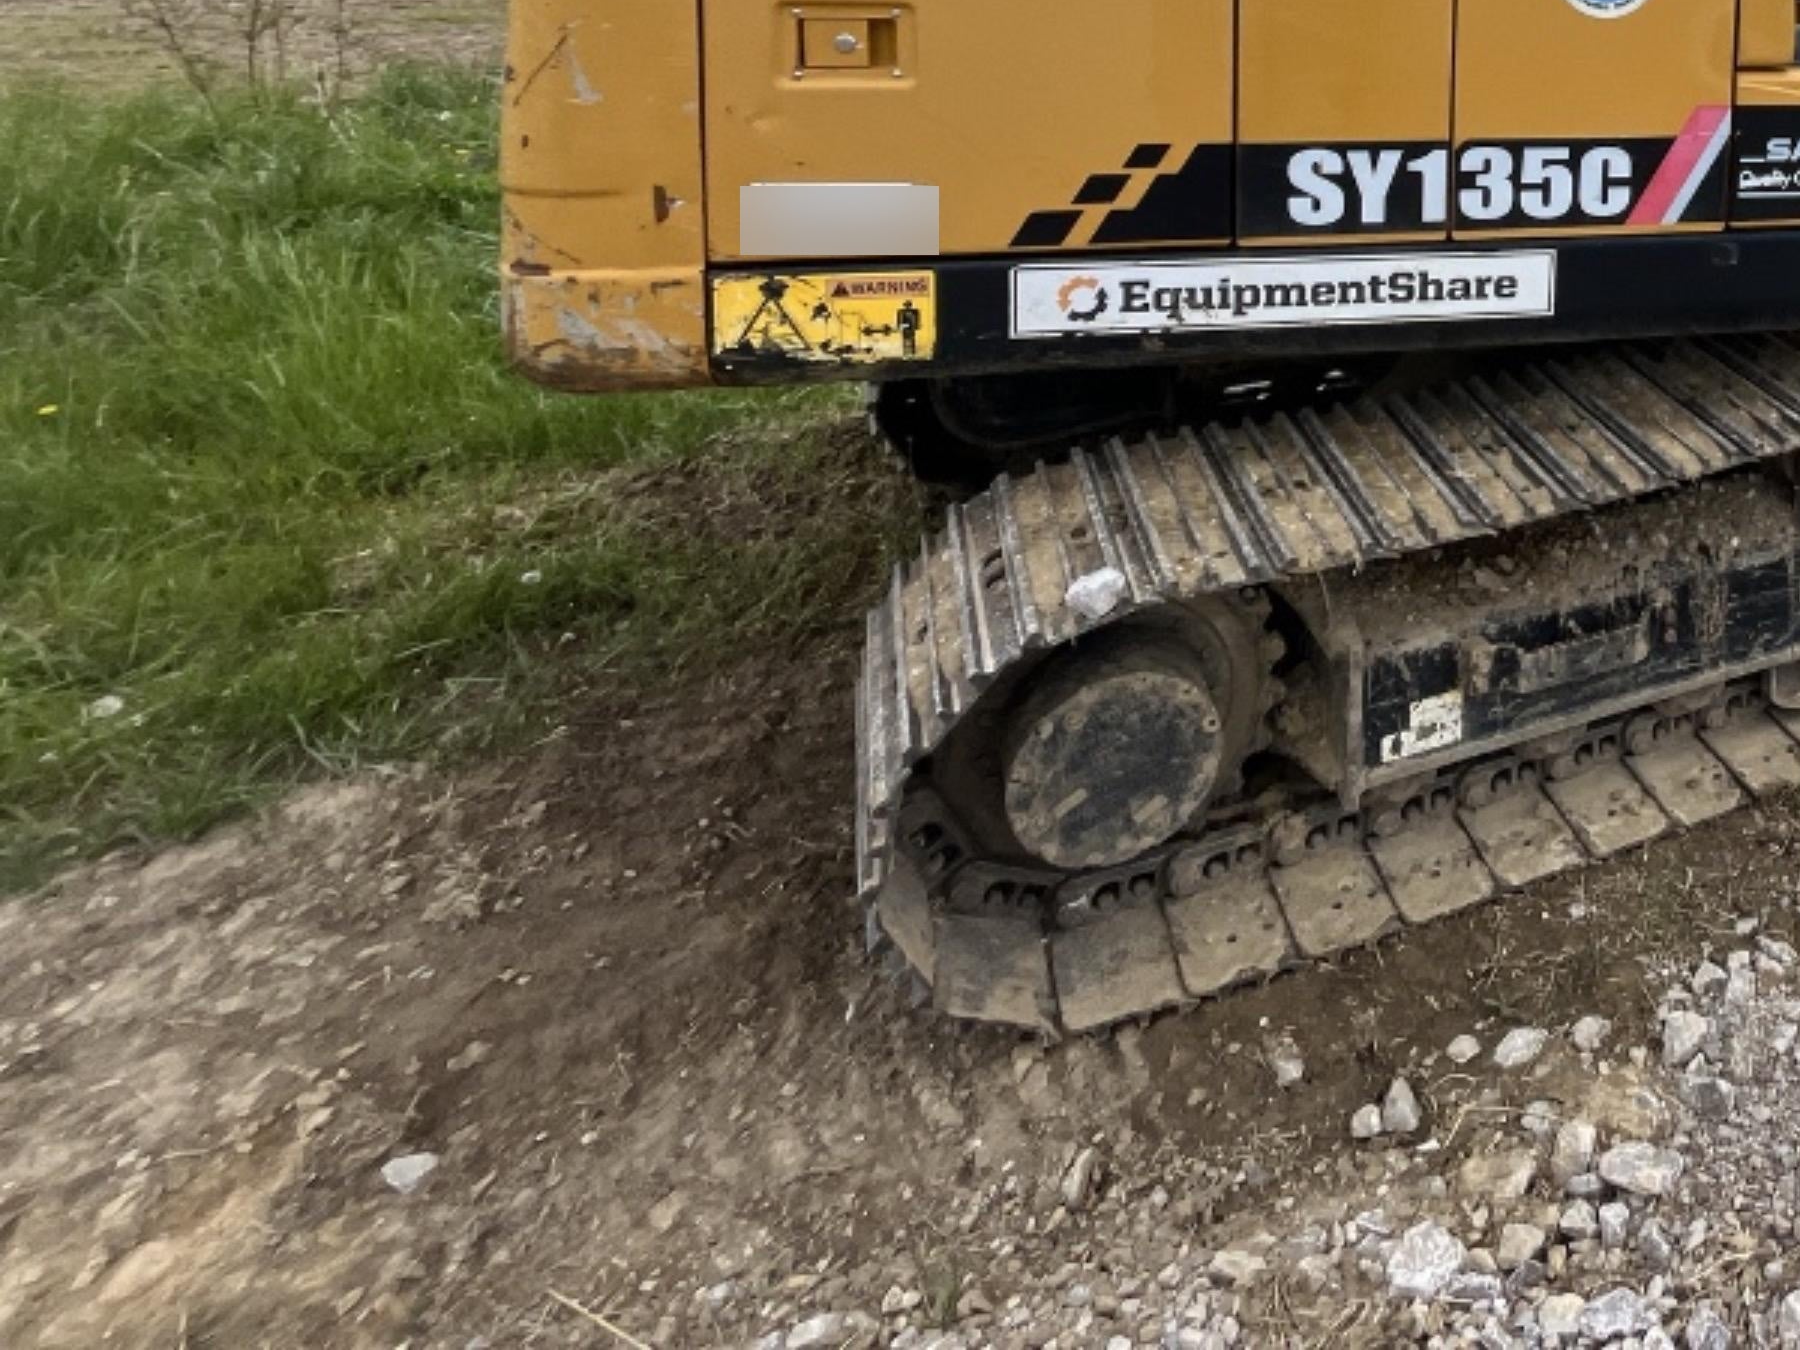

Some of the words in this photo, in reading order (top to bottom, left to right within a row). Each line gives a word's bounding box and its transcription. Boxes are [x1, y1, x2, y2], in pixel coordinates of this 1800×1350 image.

[1286, 145, 1633, 227] SY135C
[1739, 169, 1791, 190] Quality
[851, 276, 928, 295] WARNING
[1118, 271, 1519, 323] EquipmentShare
